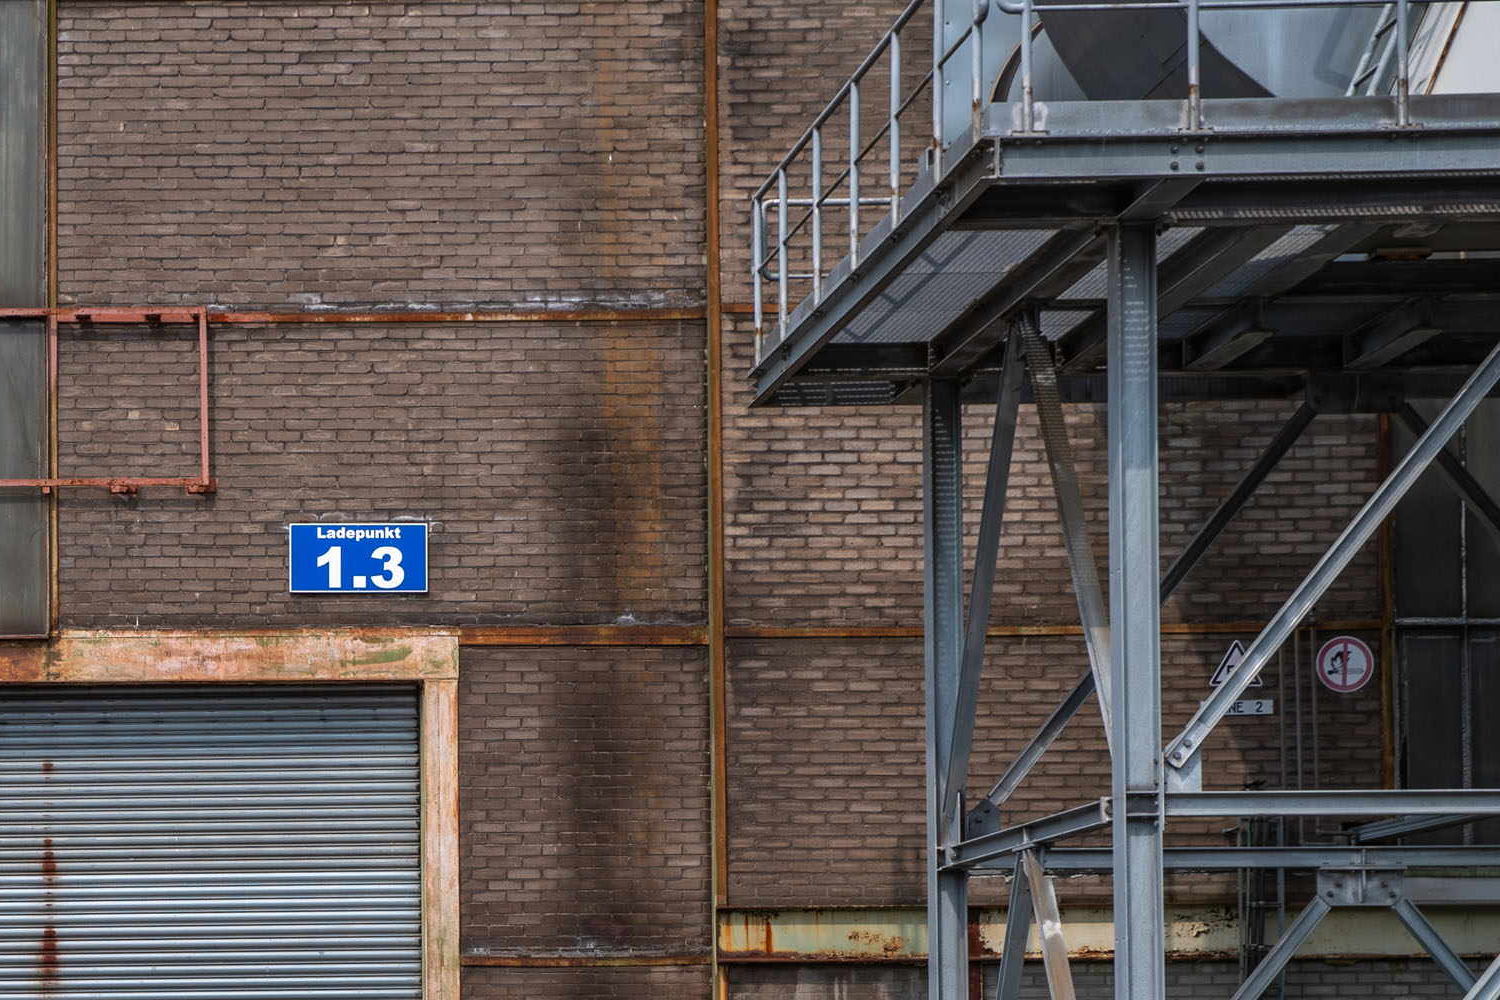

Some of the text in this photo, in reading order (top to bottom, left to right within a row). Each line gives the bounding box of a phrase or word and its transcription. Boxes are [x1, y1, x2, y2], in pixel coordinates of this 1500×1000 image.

[316, 526, 402, 542] Ladepunkt
[316, 545, 405, 589] 1.3
[1255, 701, 1263, 713] 2
